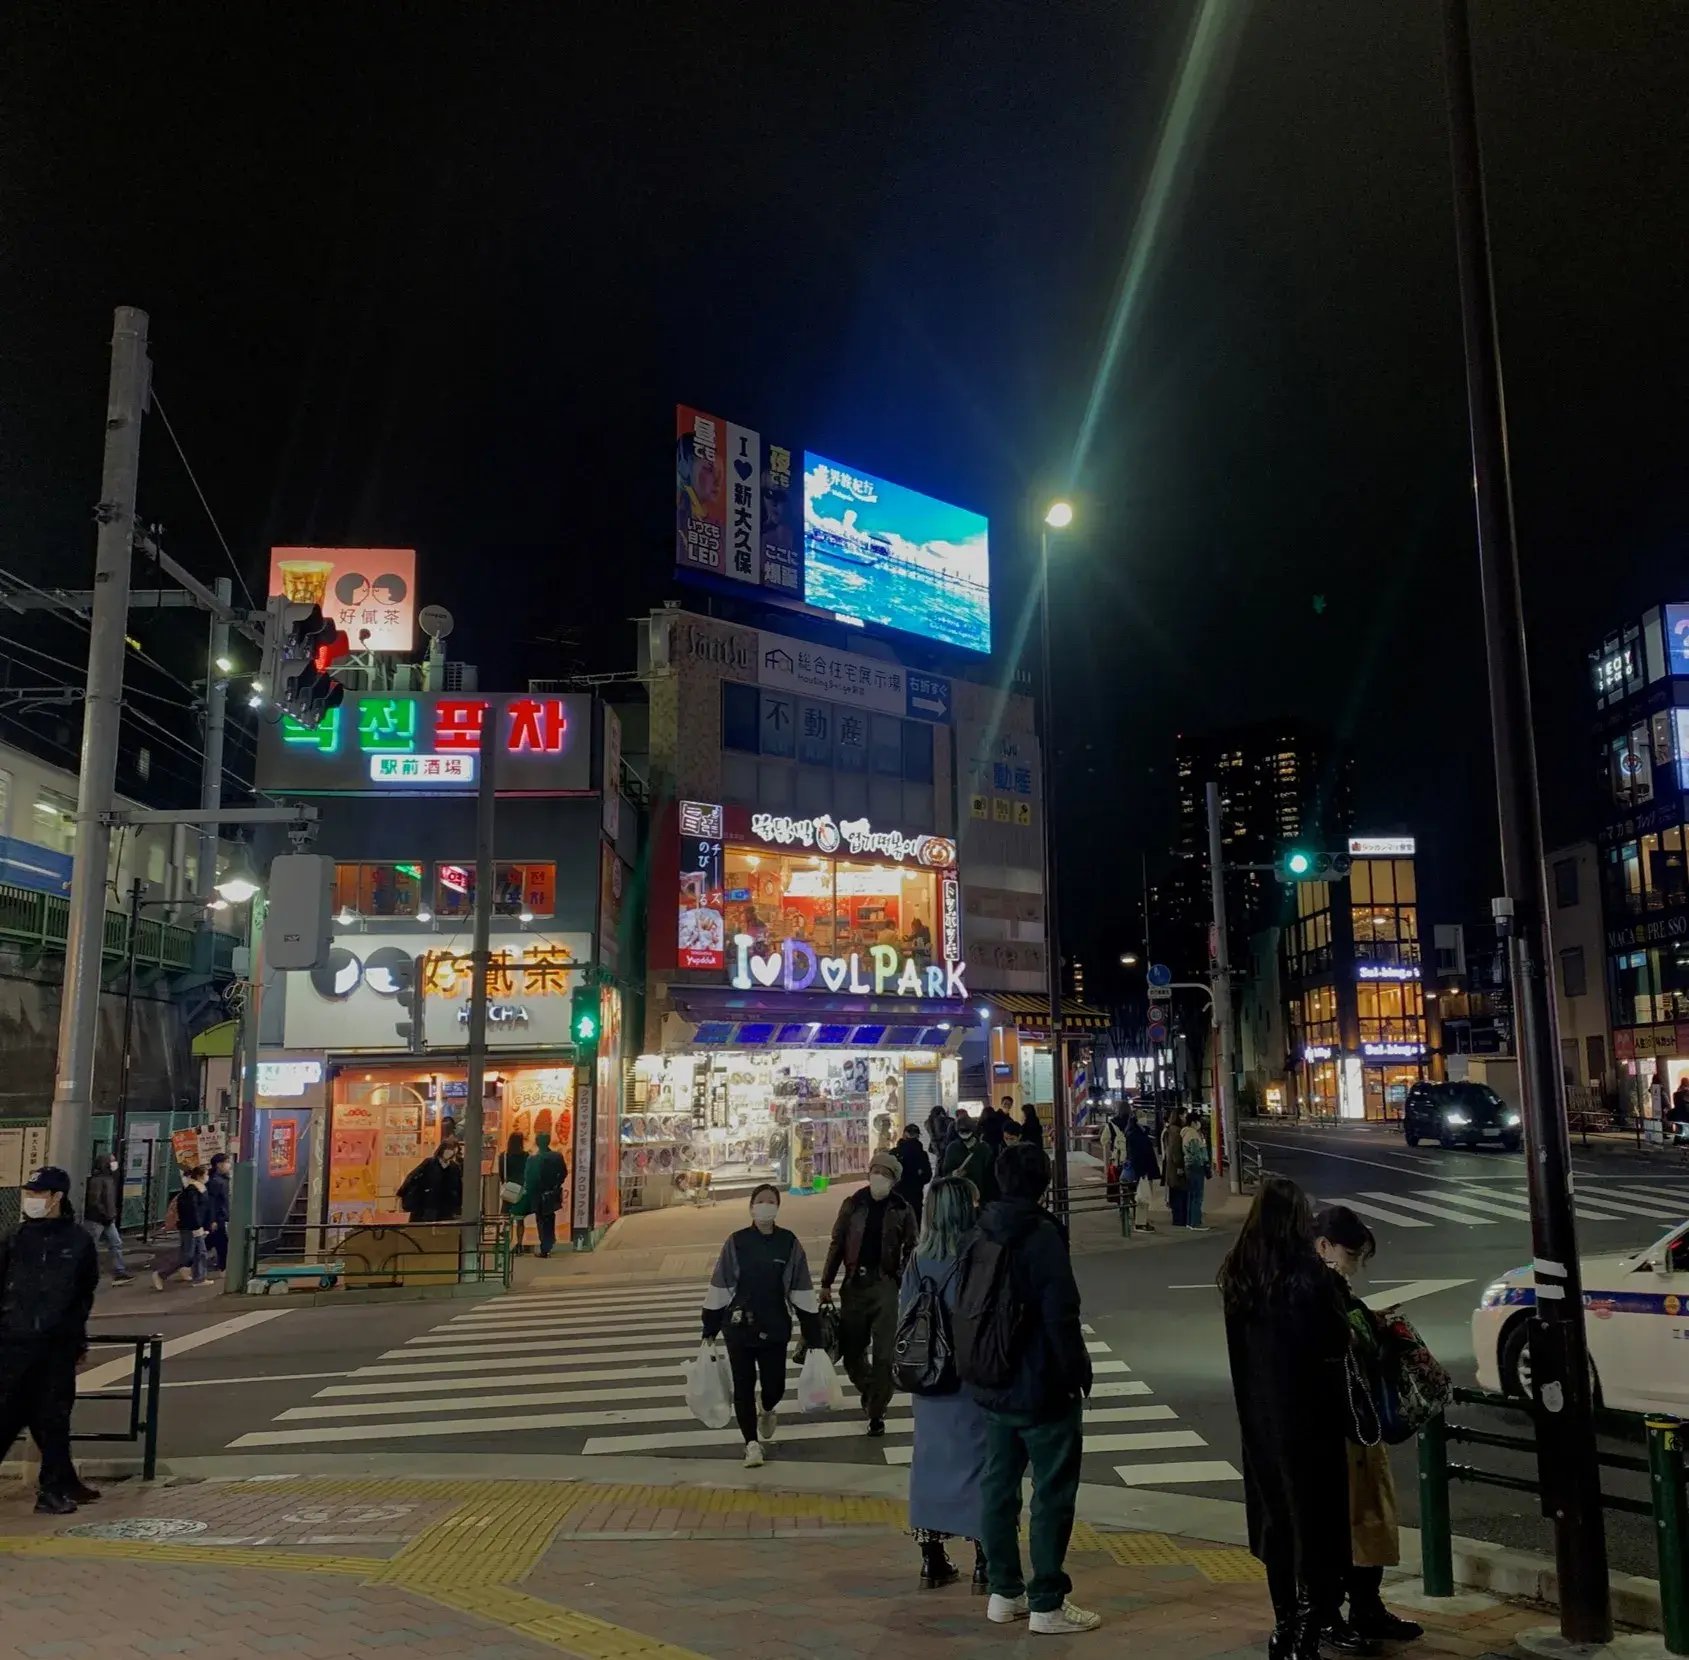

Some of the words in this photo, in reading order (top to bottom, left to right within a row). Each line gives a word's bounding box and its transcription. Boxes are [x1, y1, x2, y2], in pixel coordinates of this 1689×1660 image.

[739, 437, 748, 457] I
[687, 517, 720, 539] いつでも
[734, 482, 752, 574] 新大久保
[687, 530, 720, 552] 目立つ
[687, 545, 719, 567] LED
[765, 544, 798, 565] ここに
[798, 650, 901, 692] 総合住宅展示場
[909, 675, 948, 697] 右折すぐ
[766, 700, 862, 748] 不動産
[379, 758, 462, 776] 駅前酒場
[711, 844, 722, 905] チーズ
[1608, 927, 1635, 948] MACA
[1647, 915, 1688, 941] PRESSO
[457, 1006, 529, 1022] HCHA
